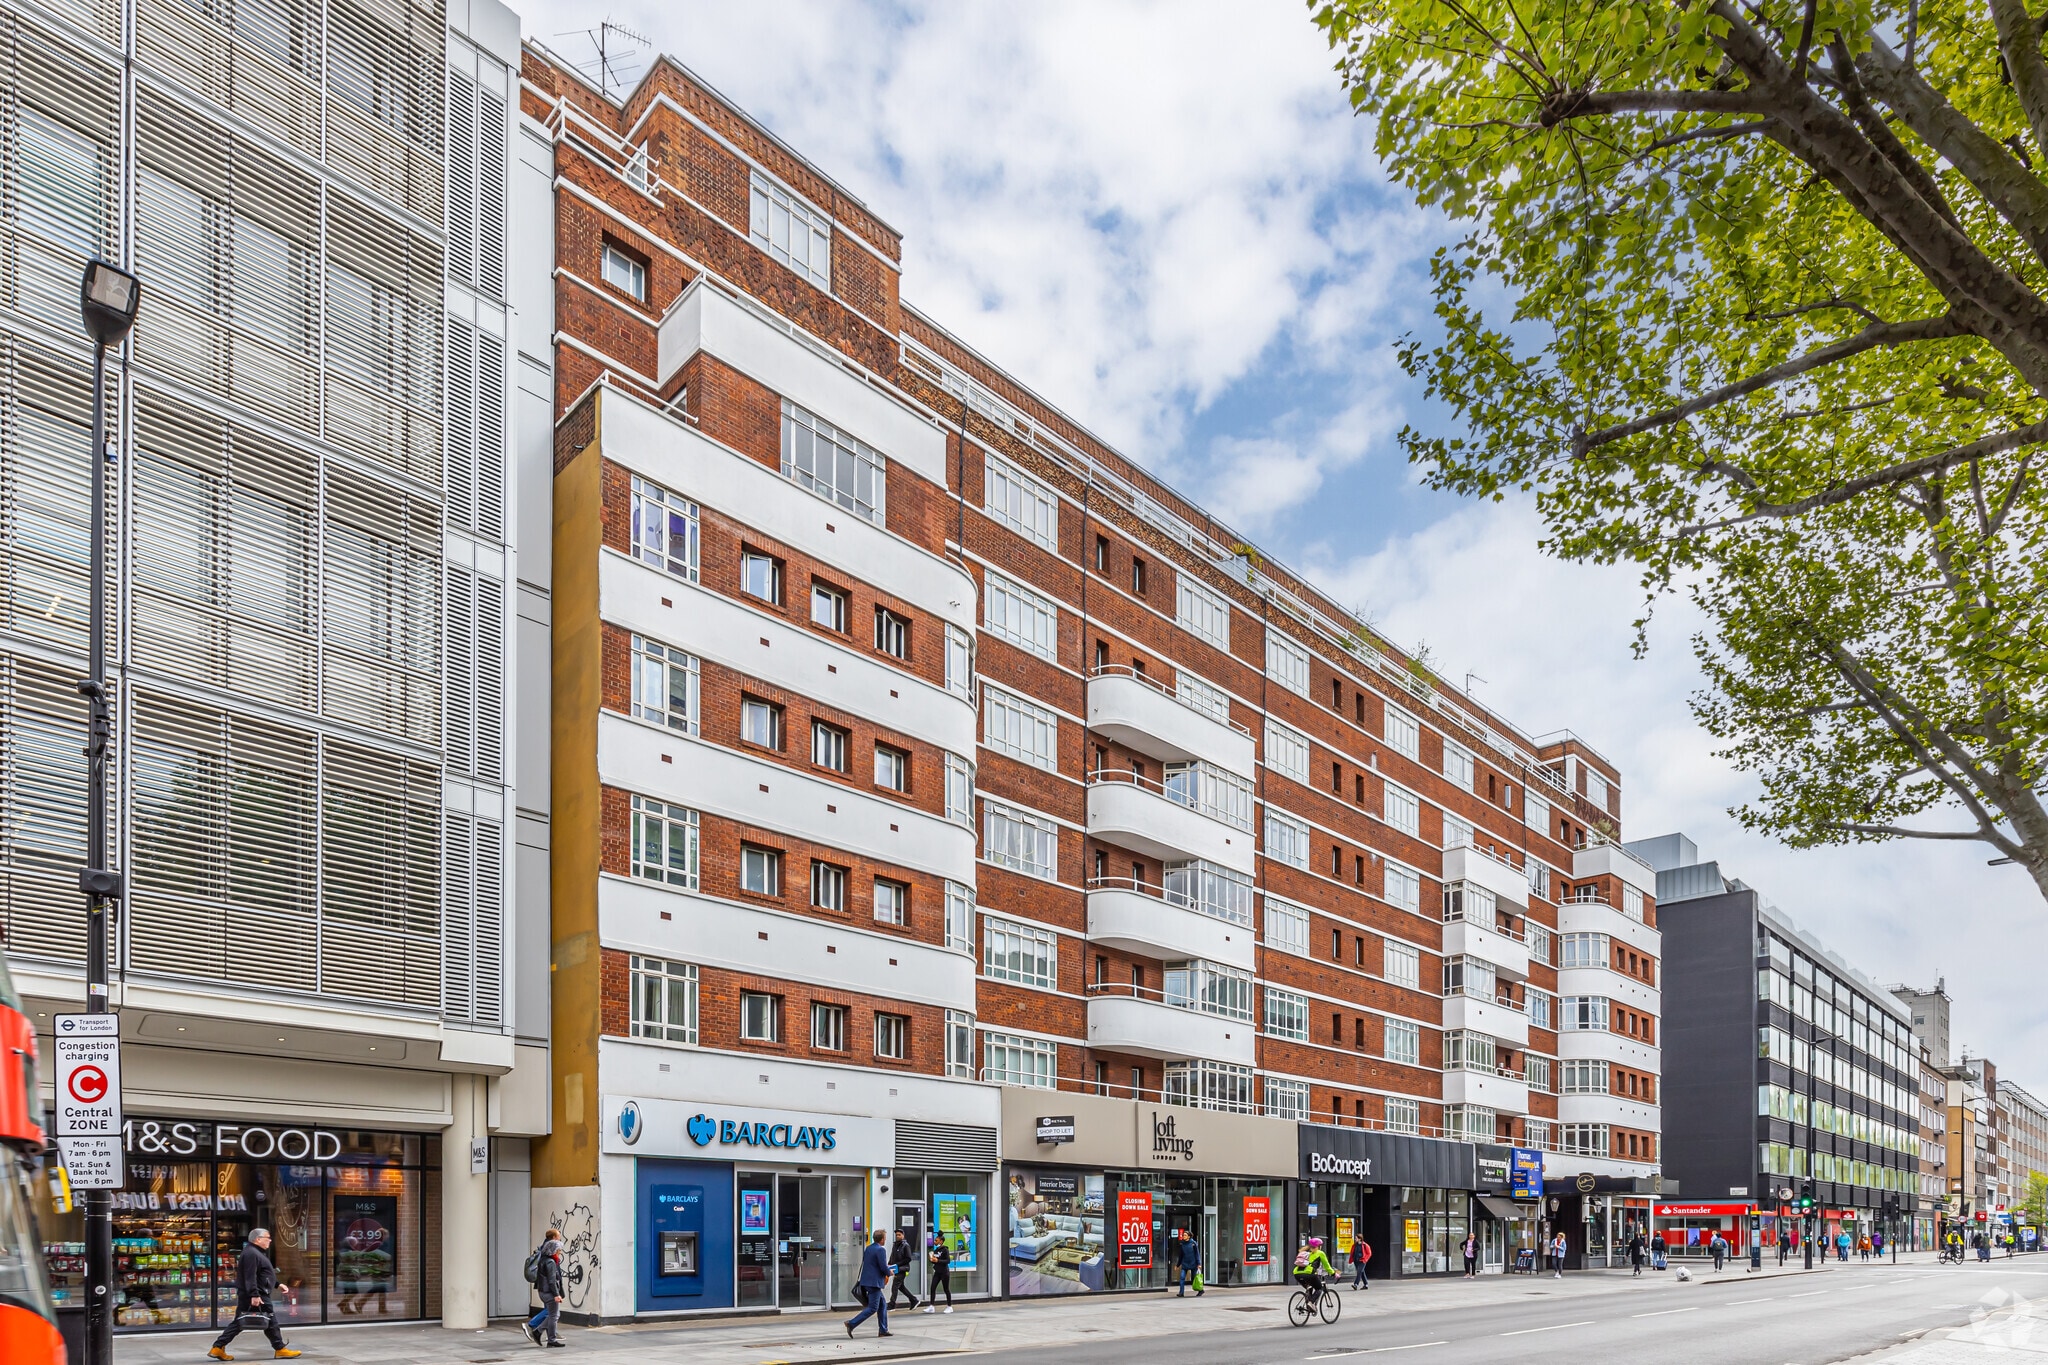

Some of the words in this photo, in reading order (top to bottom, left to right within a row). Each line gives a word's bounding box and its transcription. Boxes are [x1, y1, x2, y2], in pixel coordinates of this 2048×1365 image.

[59, 1041, 116, 1051] Congestion
[65, 1052, 109, 1061] charging
[64, 1107, 113, 1117] Central
[69, 1120, 108, 1130] ZONE
[1152, 1111, 1177, 1139] loft
[720, 1119, 837, 1150] BARCLAYS
[96, 1140, 107, 1148] Fri
[122, 1120, 198, 1155] &S
[215, 1124, 342, 1161] FOOD
[472, 1146, 486, 1159] M&S
[1311, 1152, 1371, 1180] BoConcept
[1039, 1180, 1059, 1188] Interior
[1058, 1181, 1075, 1190] Design
[666, 1195, 699, 1203] BARCLAYS
[355, 1203, 377, 1211] M&S
[1672, 1205, 1712, 1214] Santander
[350, 1229, 382, 1240] £3.99
[1121, 1222, 1149, 1243] 50%
[1246, 1223, 1268, 1242] 50%
